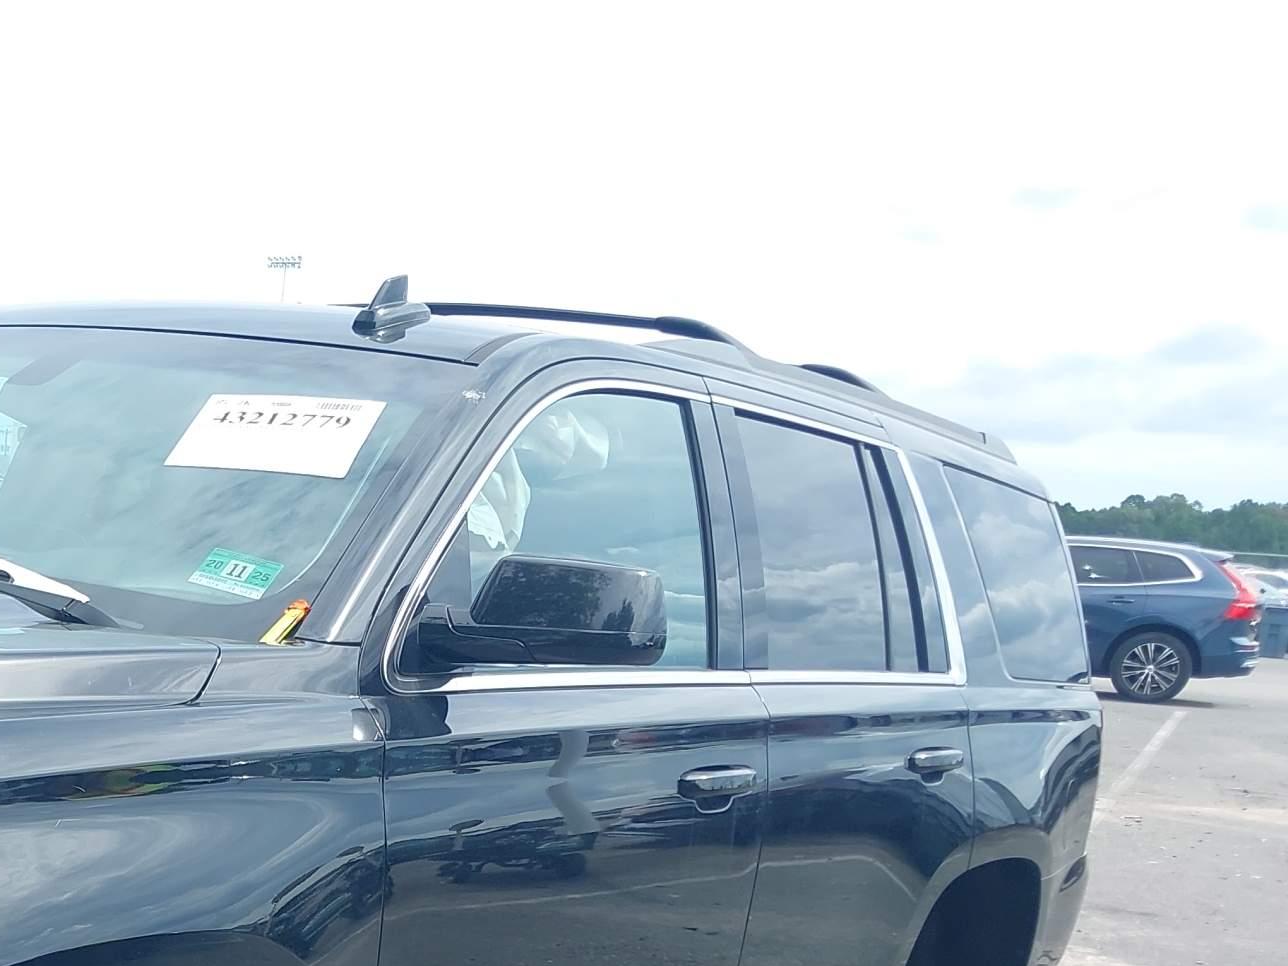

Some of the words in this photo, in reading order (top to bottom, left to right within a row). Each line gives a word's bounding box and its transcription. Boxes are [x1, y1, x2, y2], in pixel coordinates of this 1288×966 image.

[213, 411, 352, 429] 43212779
[206, 560, 224, 569] 20
[226, 563, 247, 579] 11
[252, 571, 272, 582] 25
